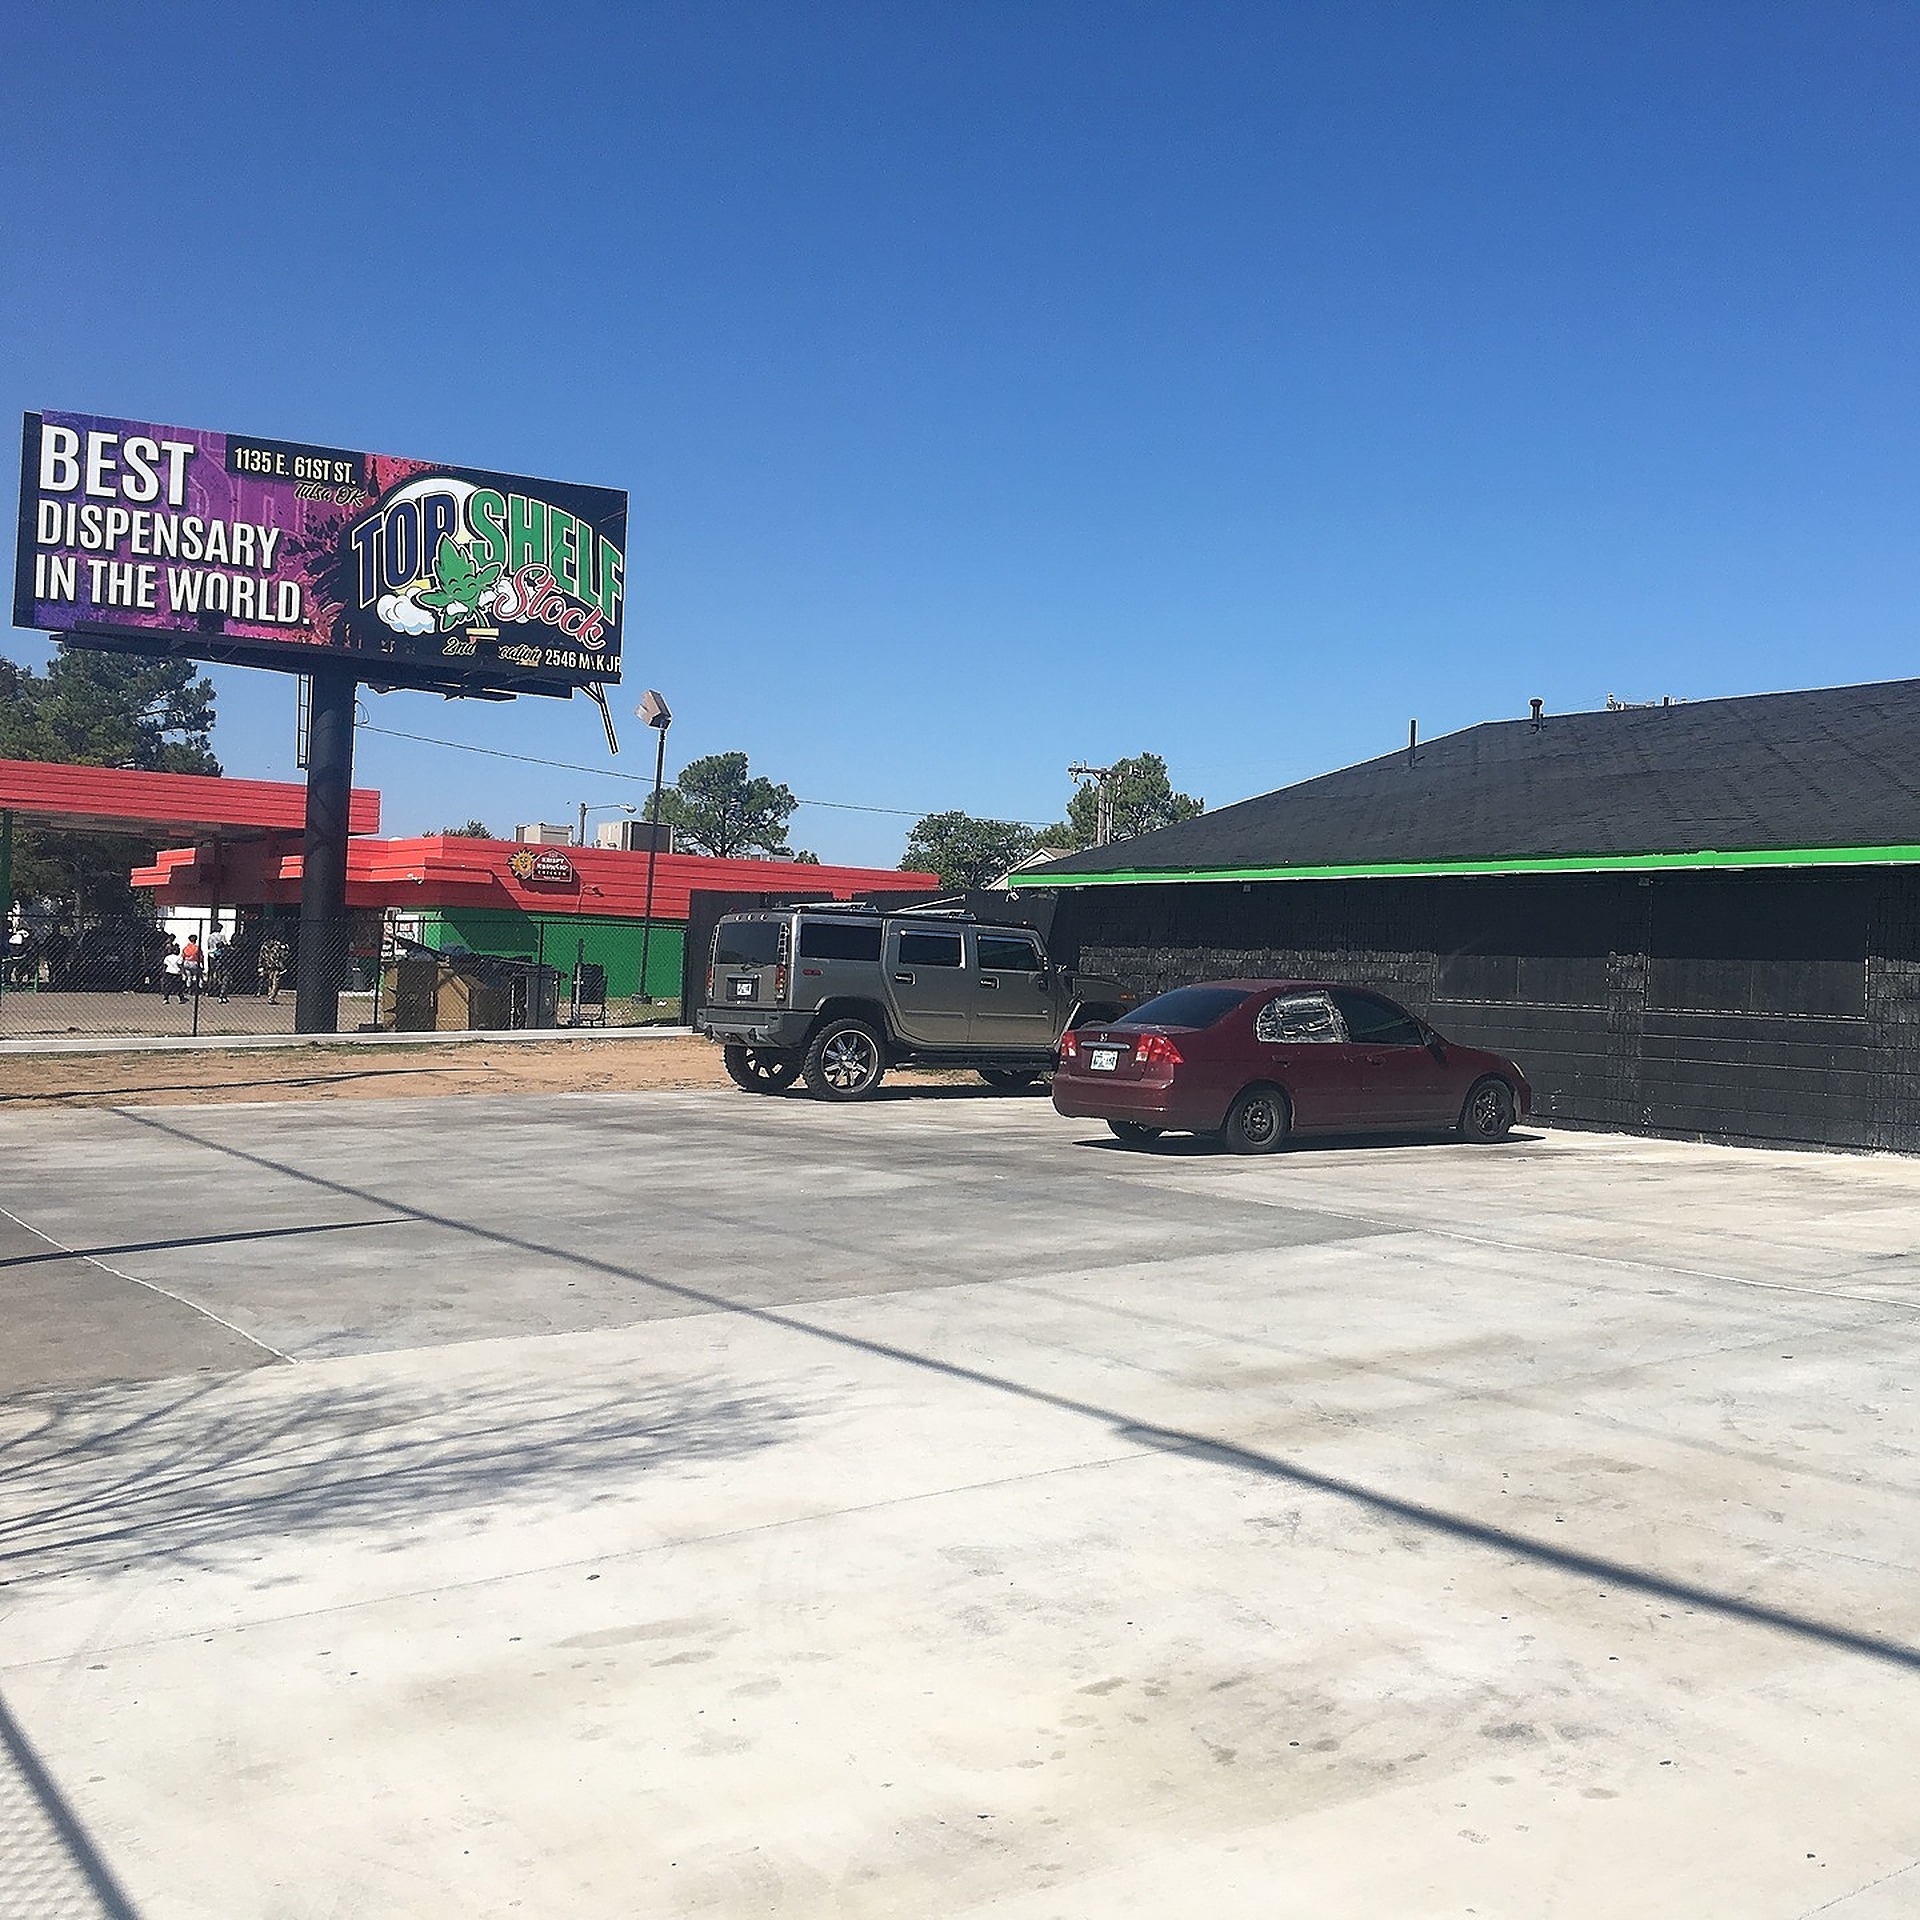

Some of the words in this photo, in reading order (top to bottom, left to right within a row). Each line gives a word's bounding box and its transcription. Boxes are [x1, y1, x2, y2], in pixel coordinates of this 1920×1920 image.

[39, 424, 194, 506] BEST
[235, 448, 271, 473] 1135
[275, 454, 289, 475] E.
[295, 457, 331, 480] 61ST
[334, 462, 356, 484] ST.
[294, 481, 333, 502] Tulsa
[37, 500, 280, 569] DISPENSARY
[351, 489, 458, 610] TOP
[469, 488, 623, 626] SHELF
[35, 554, 76, 601] IN
[88, 560, 156, 609] THE
[167, 567, 310, 625] WORLD.
[493, 563, 606, 650] Stock
[545, 649, 576, 668] 2546
